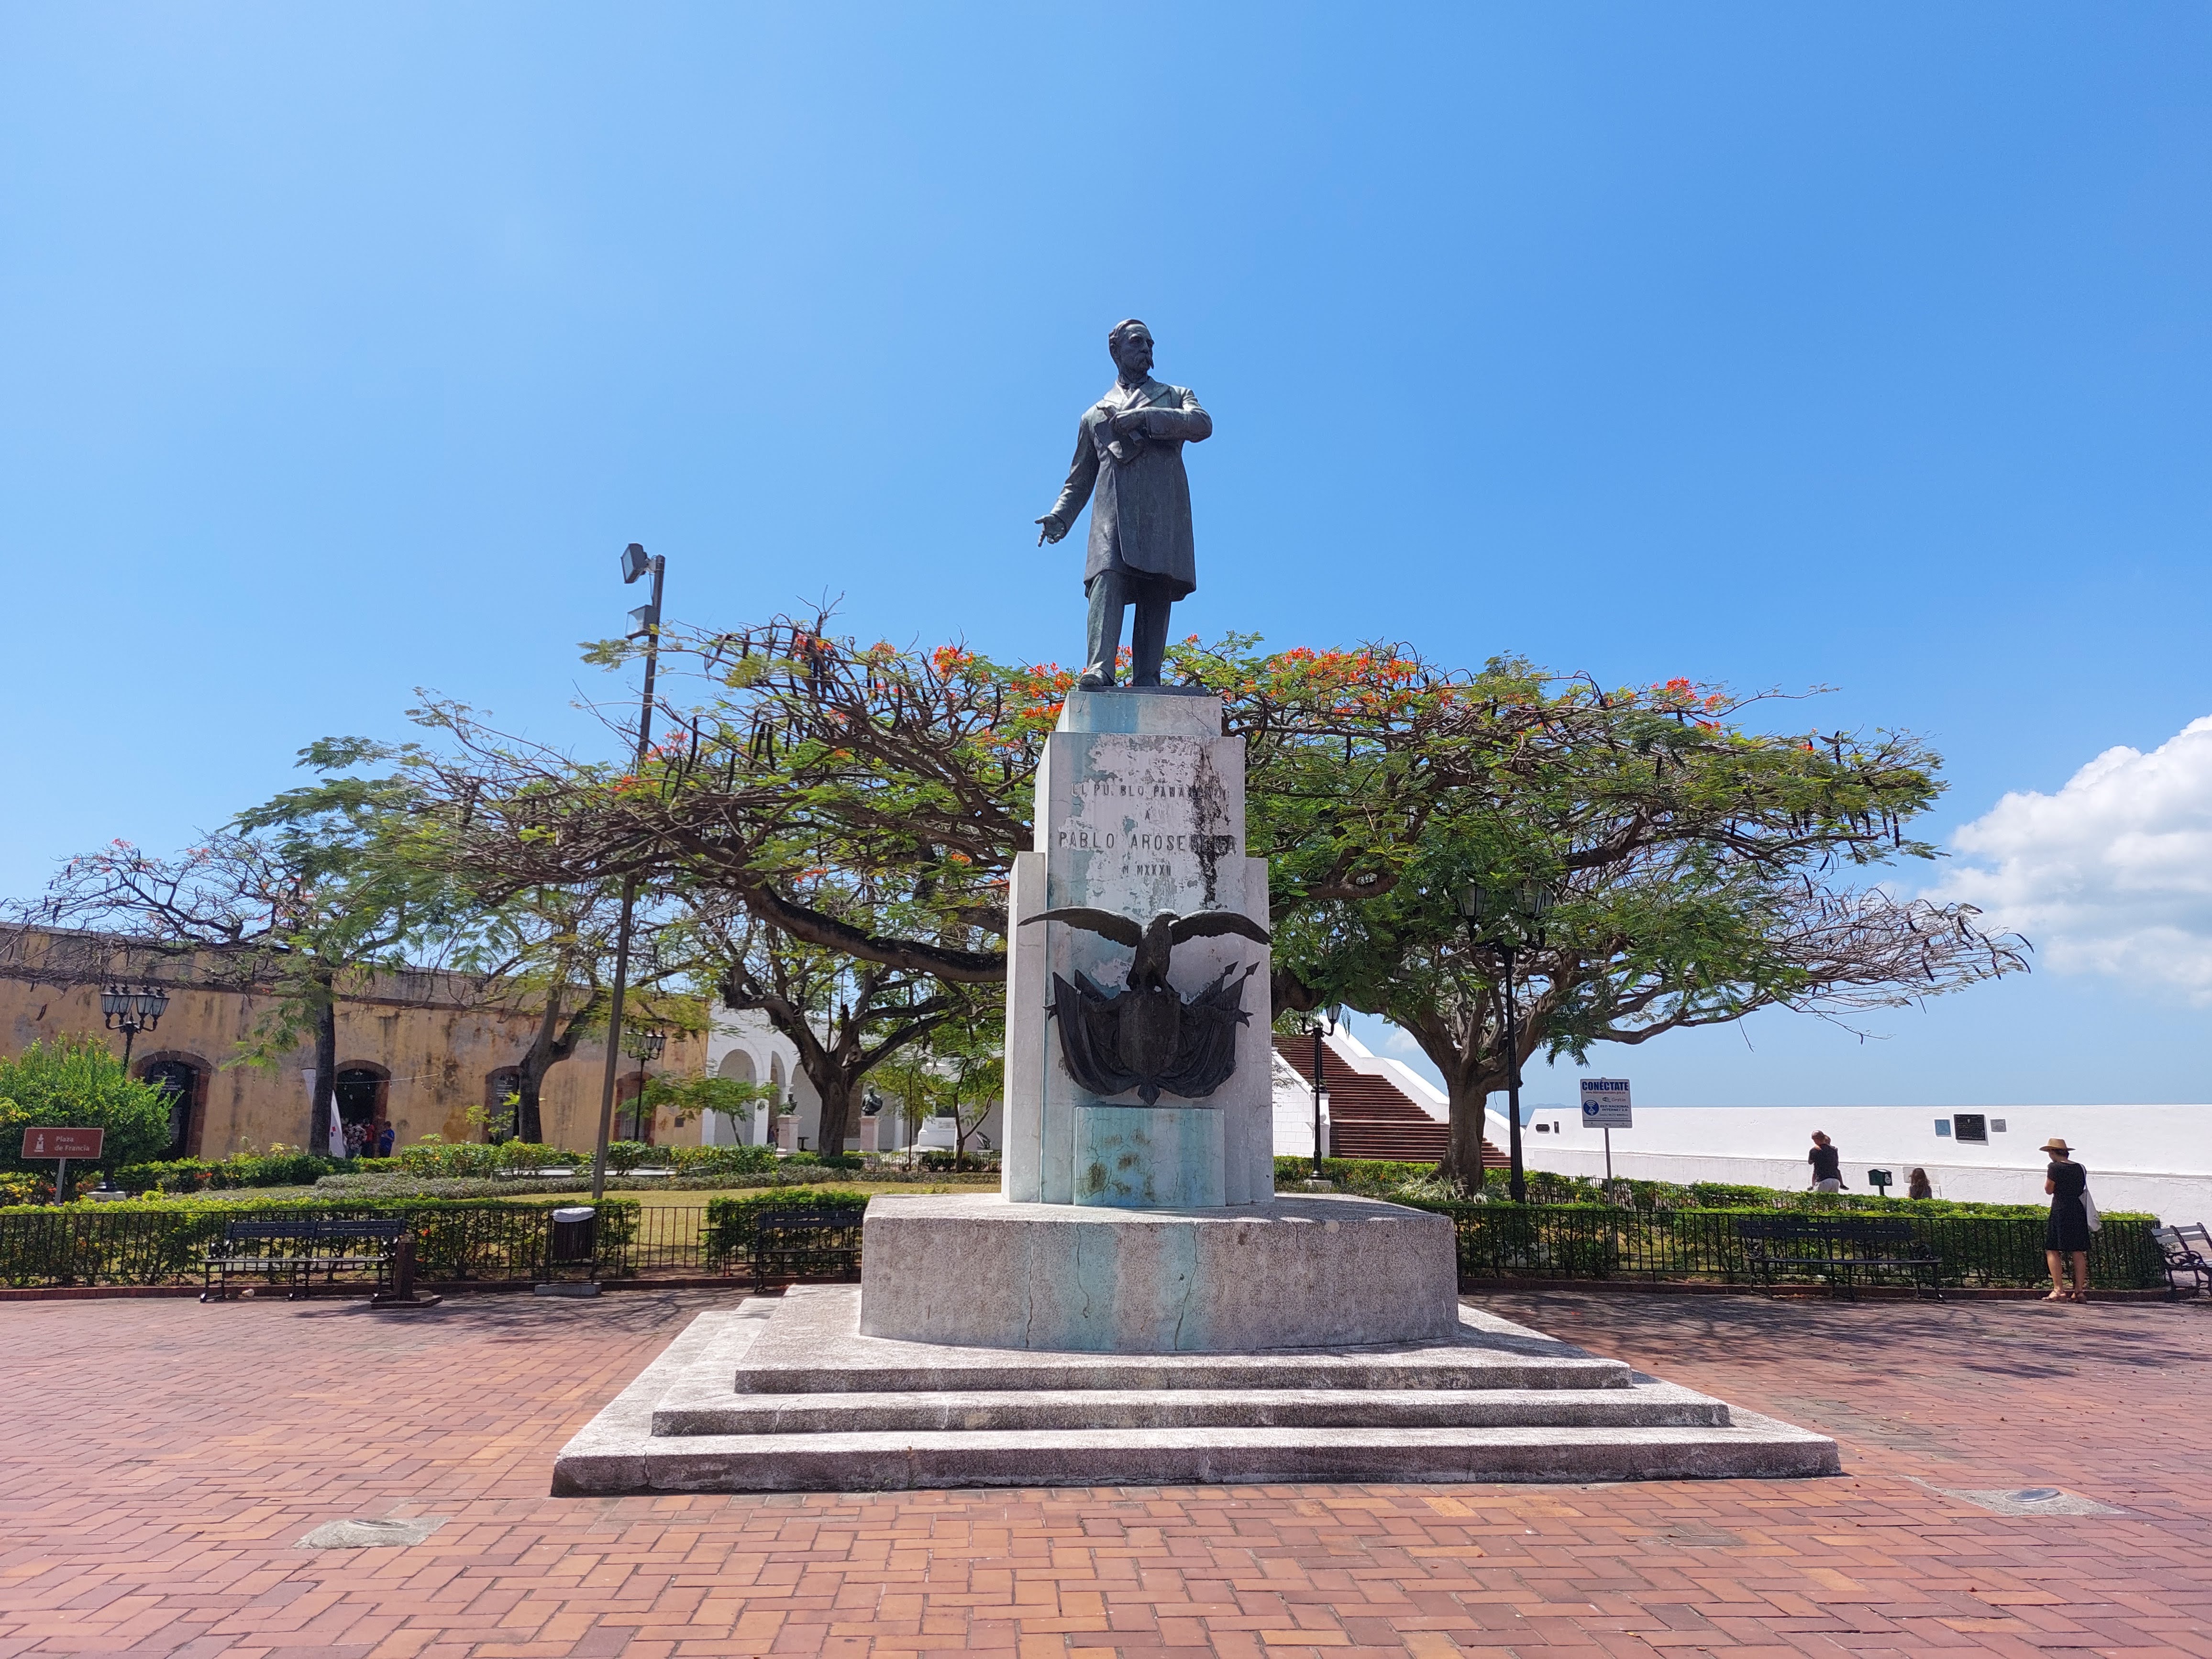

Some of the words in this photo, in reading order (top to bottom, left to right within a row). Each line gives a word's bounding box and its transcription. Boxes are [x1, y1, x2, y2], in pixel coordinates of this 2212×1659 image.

[1144, 810, 1150, 820] A
[1059, 831, 1114, 849] PABLO
[1130, 833, 1236, 854] AROSEMENA
[1582, 1080, 1629, 1091] CONÉCTATE
